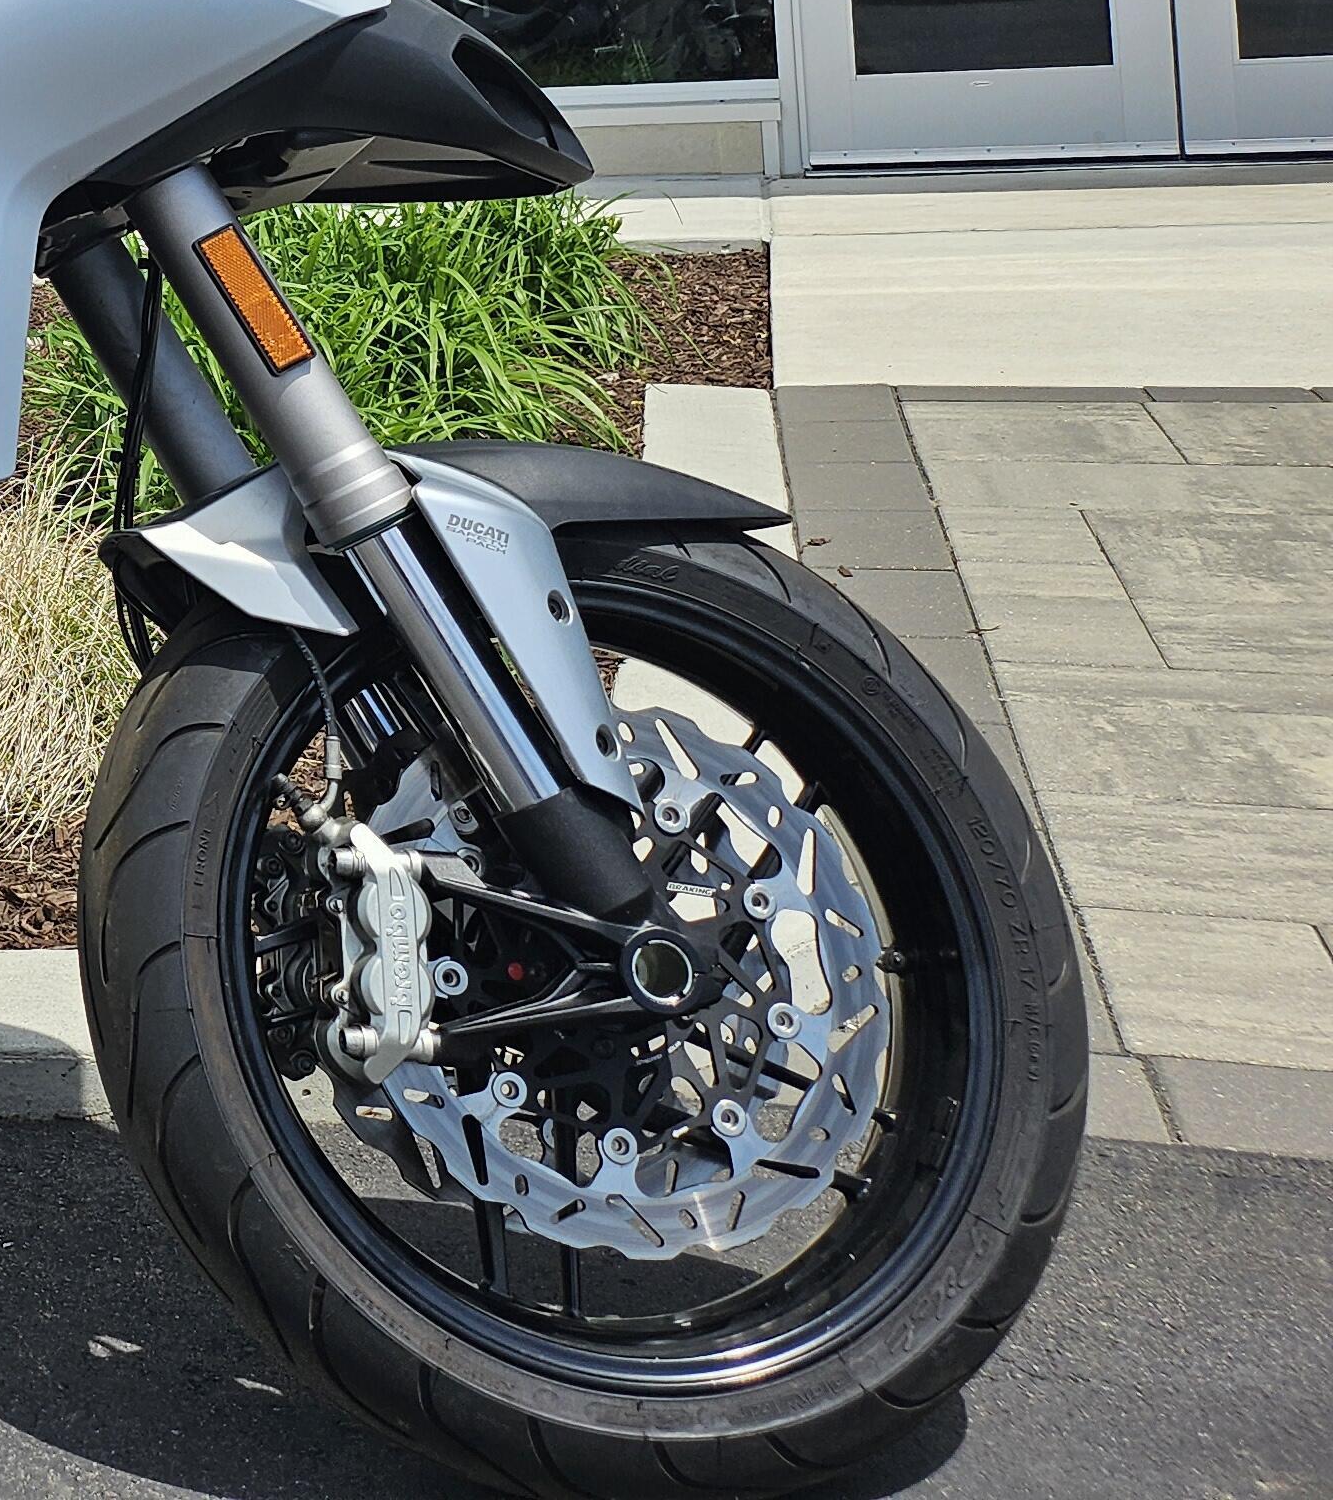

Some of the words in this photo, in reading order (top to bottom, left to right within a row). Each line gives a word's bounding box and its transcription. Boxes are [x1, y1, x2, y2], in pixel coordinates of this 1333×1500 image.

[447, 513, 510, 544] DUCATI
[668, 883, 714, 897] BRAKING
[386, 901, 413, 1007] brembo
